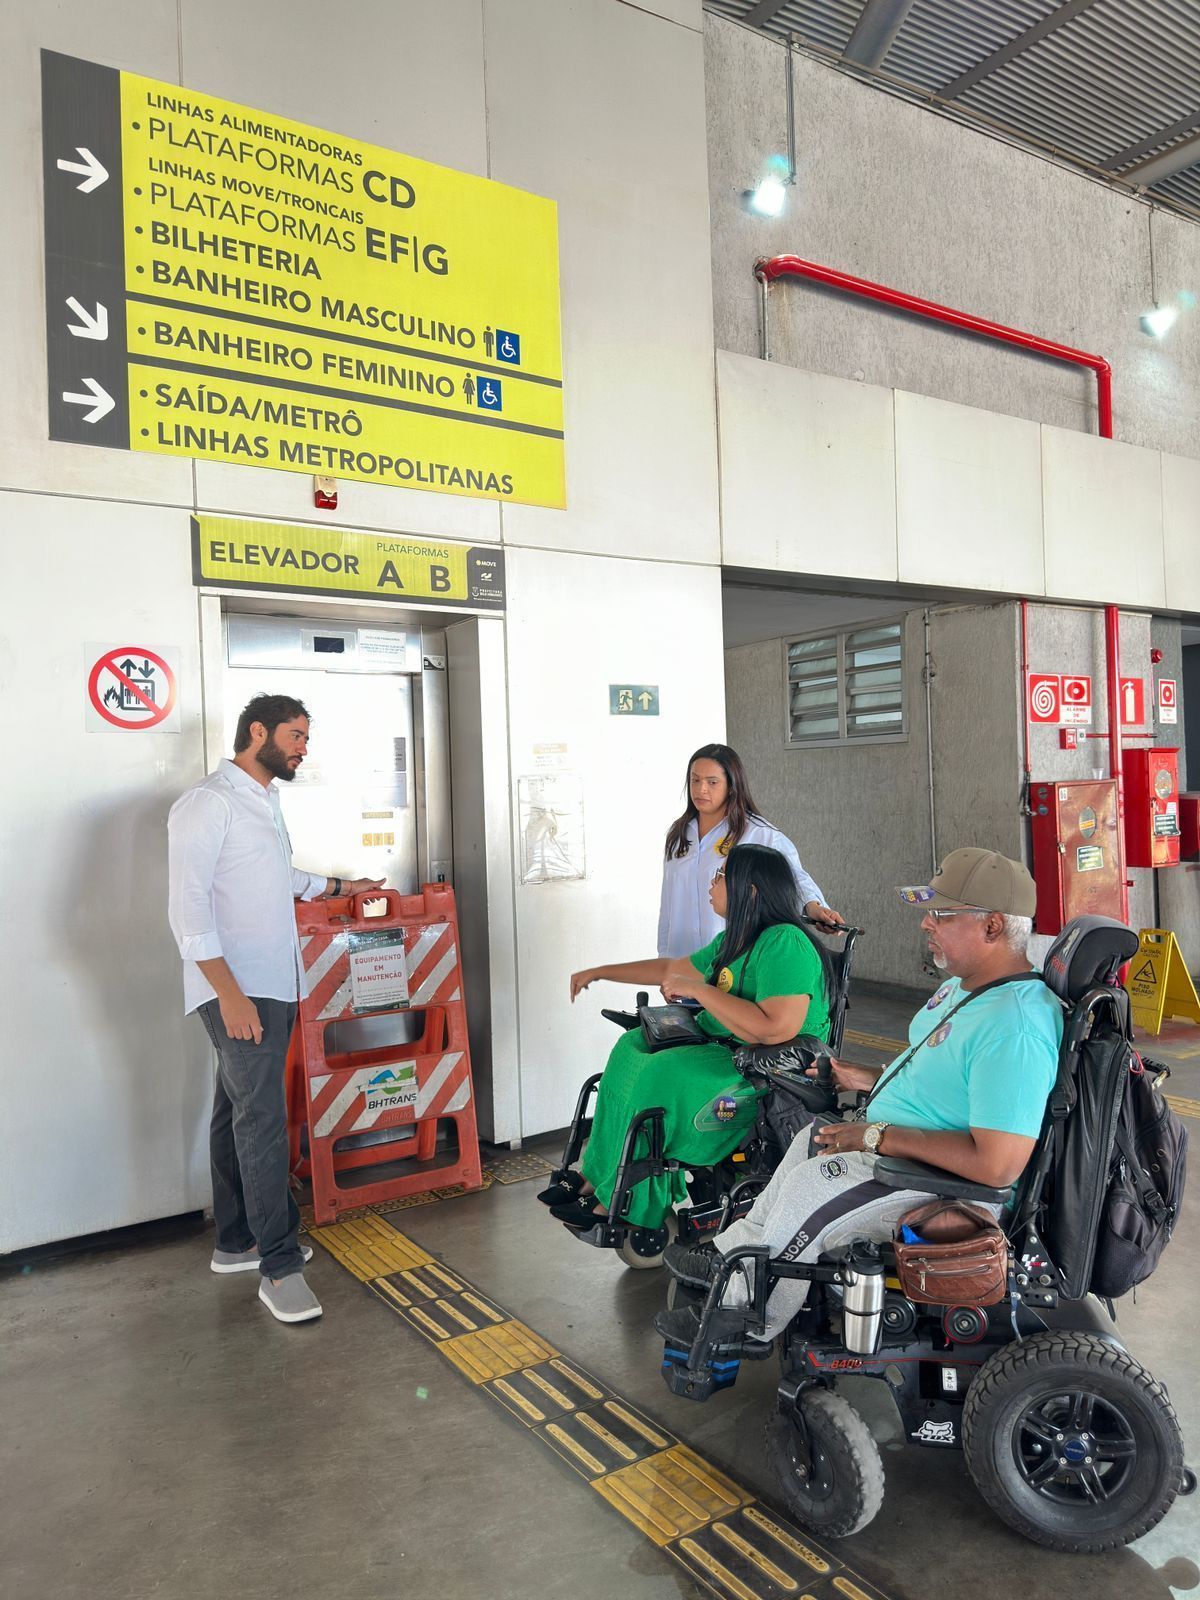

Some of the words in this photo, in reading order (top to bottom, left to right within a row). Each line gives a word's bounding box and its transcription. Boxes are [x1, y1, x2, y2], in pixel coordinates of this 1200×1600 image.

[147, 92, 214, 122] LINHAS
[219, 114, 363, 166] ALIMENTADORAS
[149, 117, 354, 193] PLATAFORMAS
[362, 170, 416, 209] CD
[149, 157, 216, 185] LINHAS
[222, 175, 364, 225] MOVE/TRONCAIS
[151, 182, 355, 252] PLATAFORMAS
[151, 220, 322, 280] BILHETERIA
[152, 260, 311, 313] BANHEIRO
[321, 296, 476, 349] MASCULINO
[154, 320, 313, 371] BANHEIRO
[323, 353, 455, 397] FEMININO
[155, 383, 362, 437] SAÍDA/METRÔ
[157, 421, 269, 458] LINHAS
[279, 439, 514, 494] METROPOLITANAS
[210, 540, 360, 575] ELEVADOR
[376, 542, 450, 559] PLATAFORMAS
[377, 560, 404, 589] A
[430, 565, 451, 592] B
[354, 953, 402, 965] EQUIPAMENTO
[356, 971, 403, 983] MANUTENÇÃO
[368, 1093, 417, 1110] BHTRANS
[780, 1230, 810, 1261] SPOR
